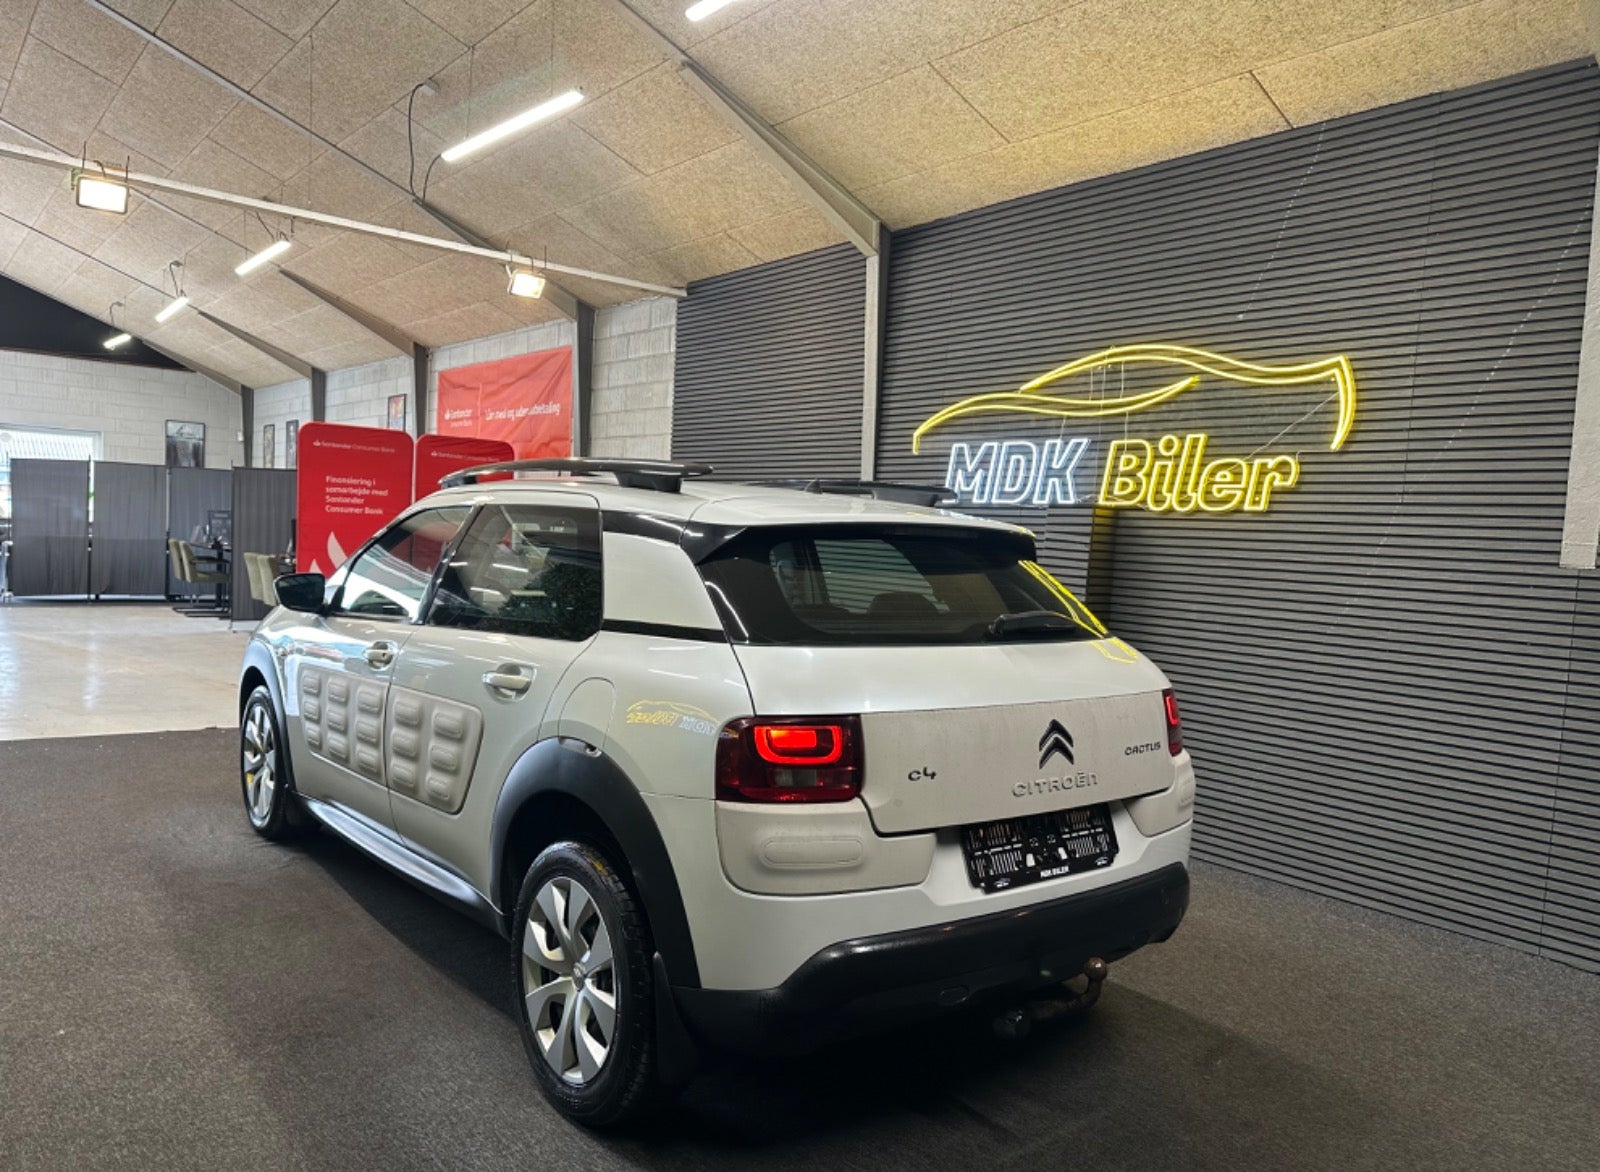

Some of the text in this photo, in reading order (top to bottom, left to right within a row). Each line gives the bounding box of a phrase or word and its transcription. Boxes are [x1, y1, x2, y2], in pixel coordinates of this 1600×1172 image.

[942, 433, 1302, 514] MDK Biler
[325, 475, 372, 487] Finansiering
[326, 487, 371, 496] samarbejde
[326, 495, 365, 505] Santander
[325, 504, 384, 515] Consumer Bank
[1124, 741, 1161, 756] CACTUS
